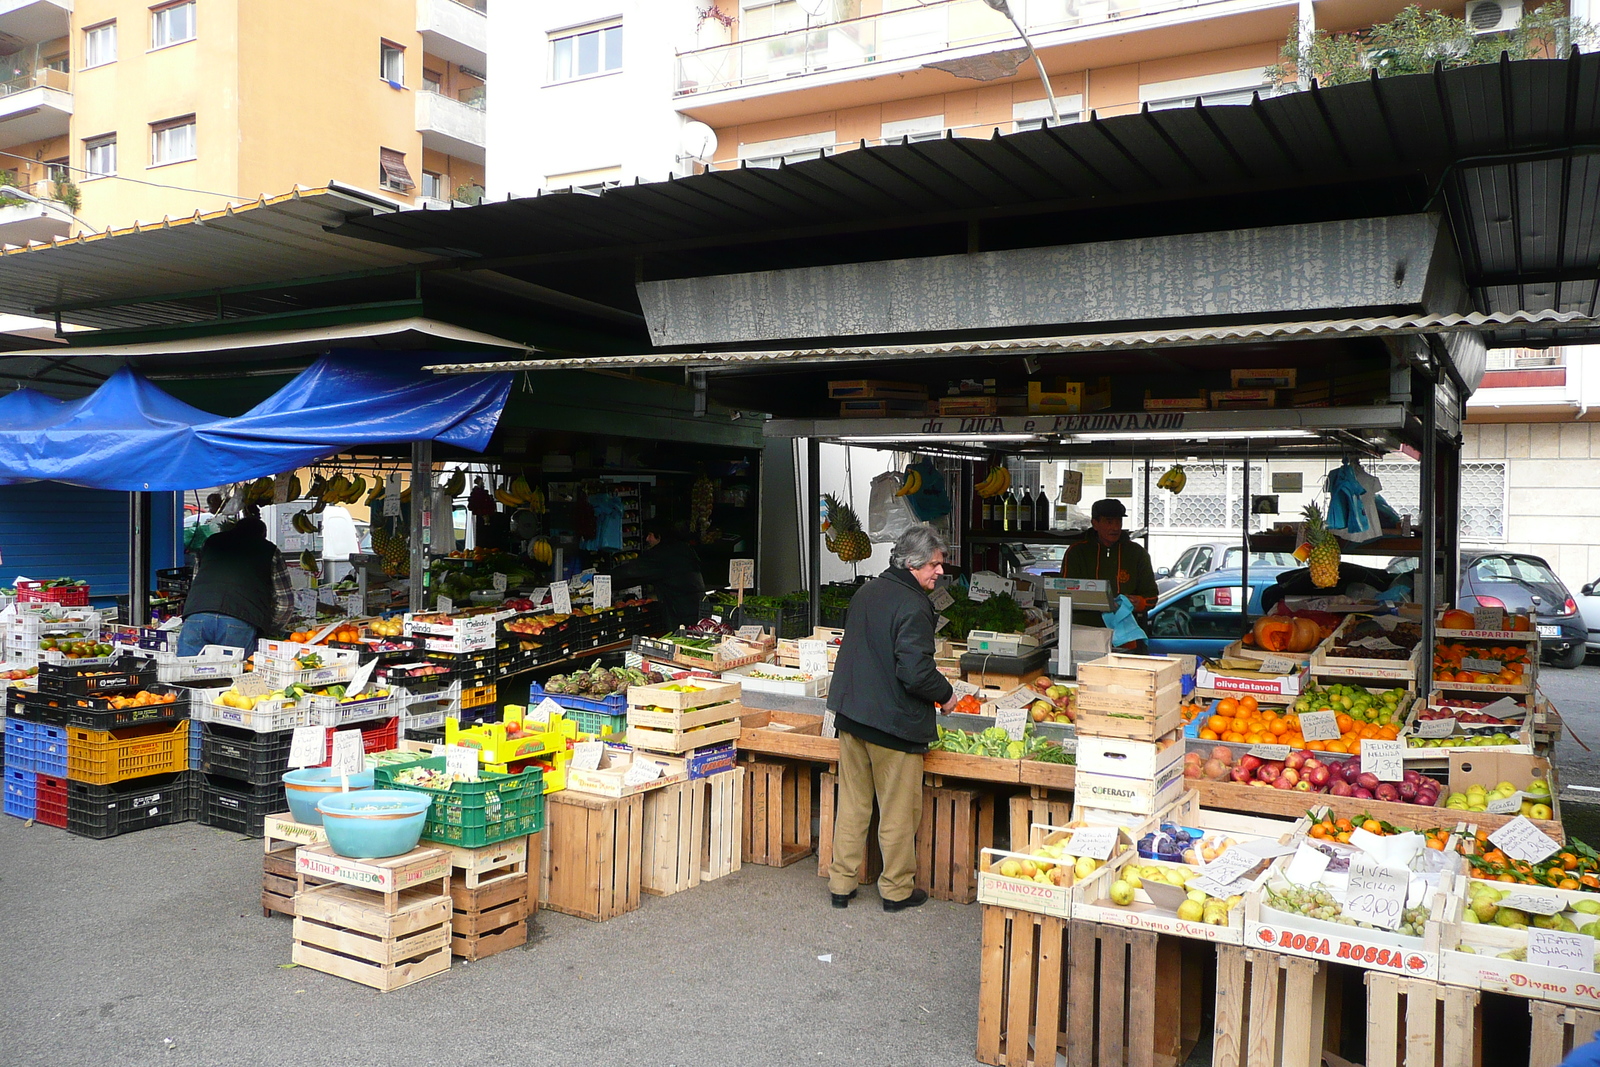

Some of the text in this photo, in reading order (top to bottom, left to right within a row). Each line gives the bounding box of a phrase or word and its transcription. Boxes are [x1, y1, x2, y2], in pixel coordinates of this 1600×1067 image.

[921, 413, 1185, 434] da LUCA e FERDINANDO
[405, 622, 431, 633] Melinda
[466, 619, 488, 629] Melinda
[465, 636, 487, 646] Melinda
[1460, 630, 1514, 638] GASPARRI
[725, 654, 761, 669] SPREAFICO
[1216, 681, 1279, 692] olive da tavola
[523, 742, 545, 754] Fruit
[1091, 786, 1137, 798] COFERASTA
[309, 861, 371, 883] GENTIL FRUIT
[1356, 864, 1393, 878] UVA
[996, 880, 1053, 898] PANNOZZO
[1350, 877, 1397, 893] SICILIA
[1126, 914, 1216, 938] Divano Mario
[1278, 930, 1403, 969] ROSA ROSSA
[1478, 969, 1500, 977] AZIENDA
[1510, 973, 1567, 993] Divano
